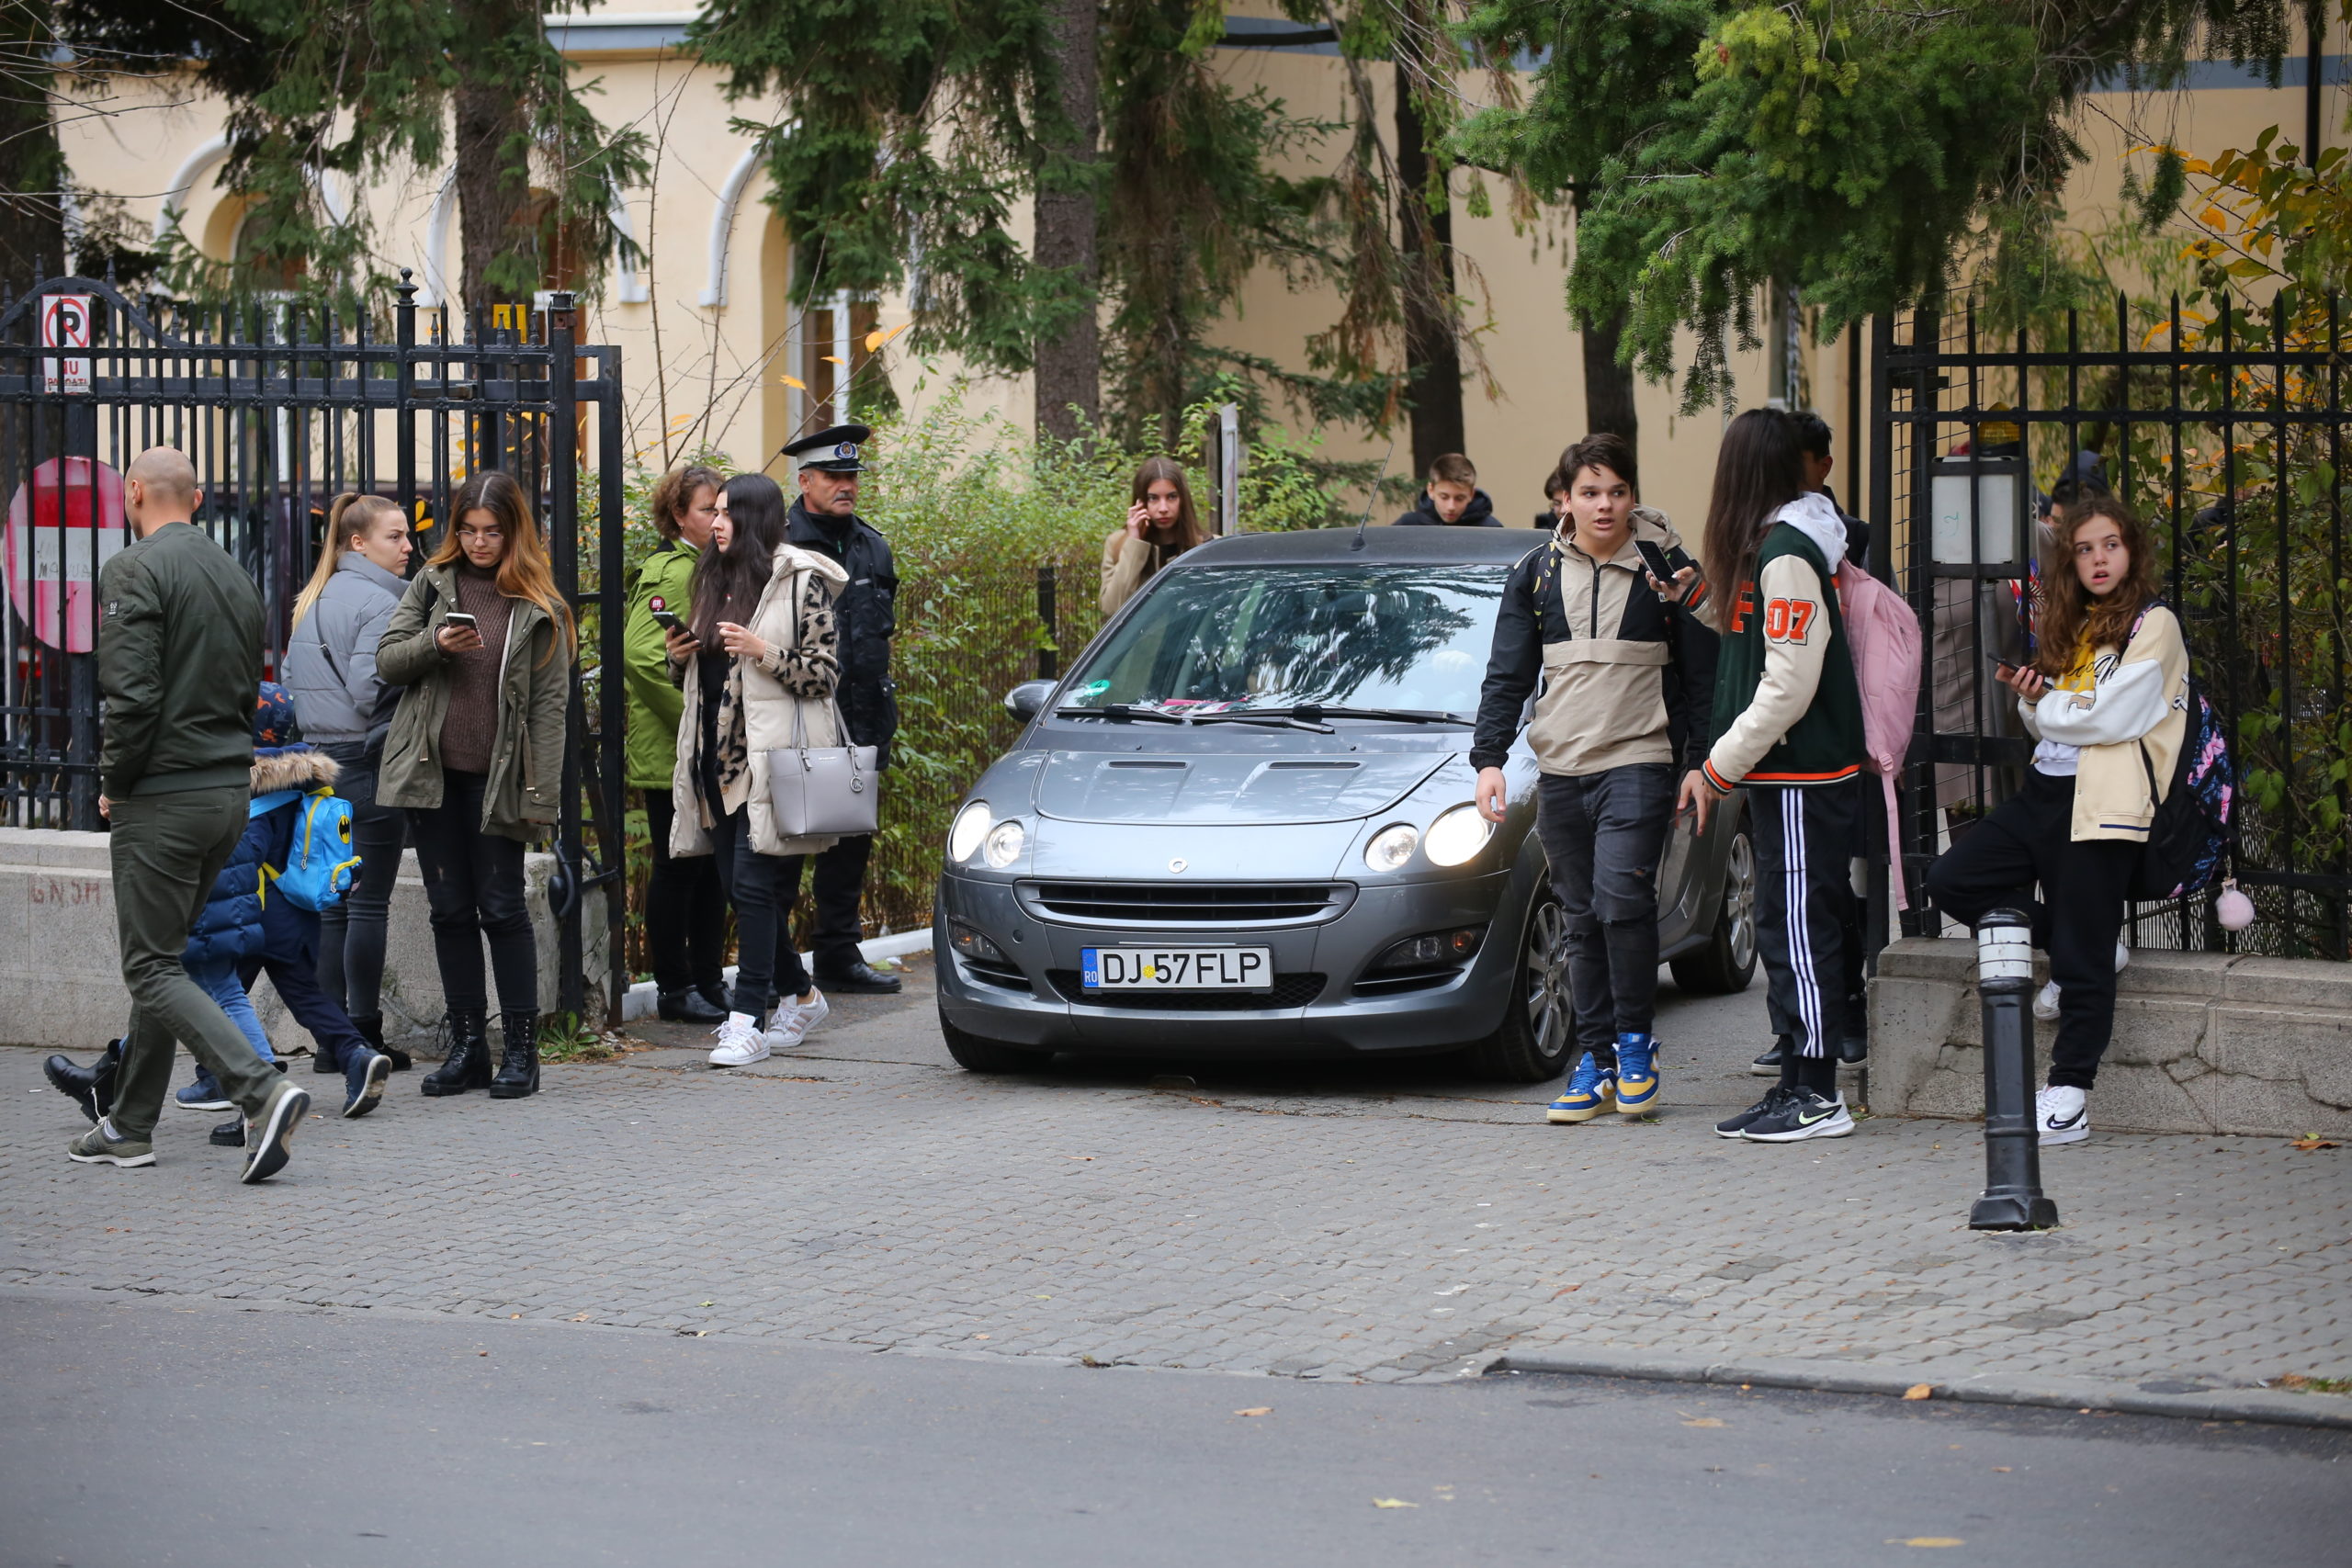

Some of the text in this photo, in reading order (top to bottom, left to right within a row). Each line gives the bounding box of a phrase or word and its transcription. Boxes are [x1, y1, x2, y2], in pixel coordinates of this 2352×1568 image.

[1766, 597, 1817, 646] 07
[1084, 970, 1098, 983] RO
[1103, 953, 1142, 984] DJ
